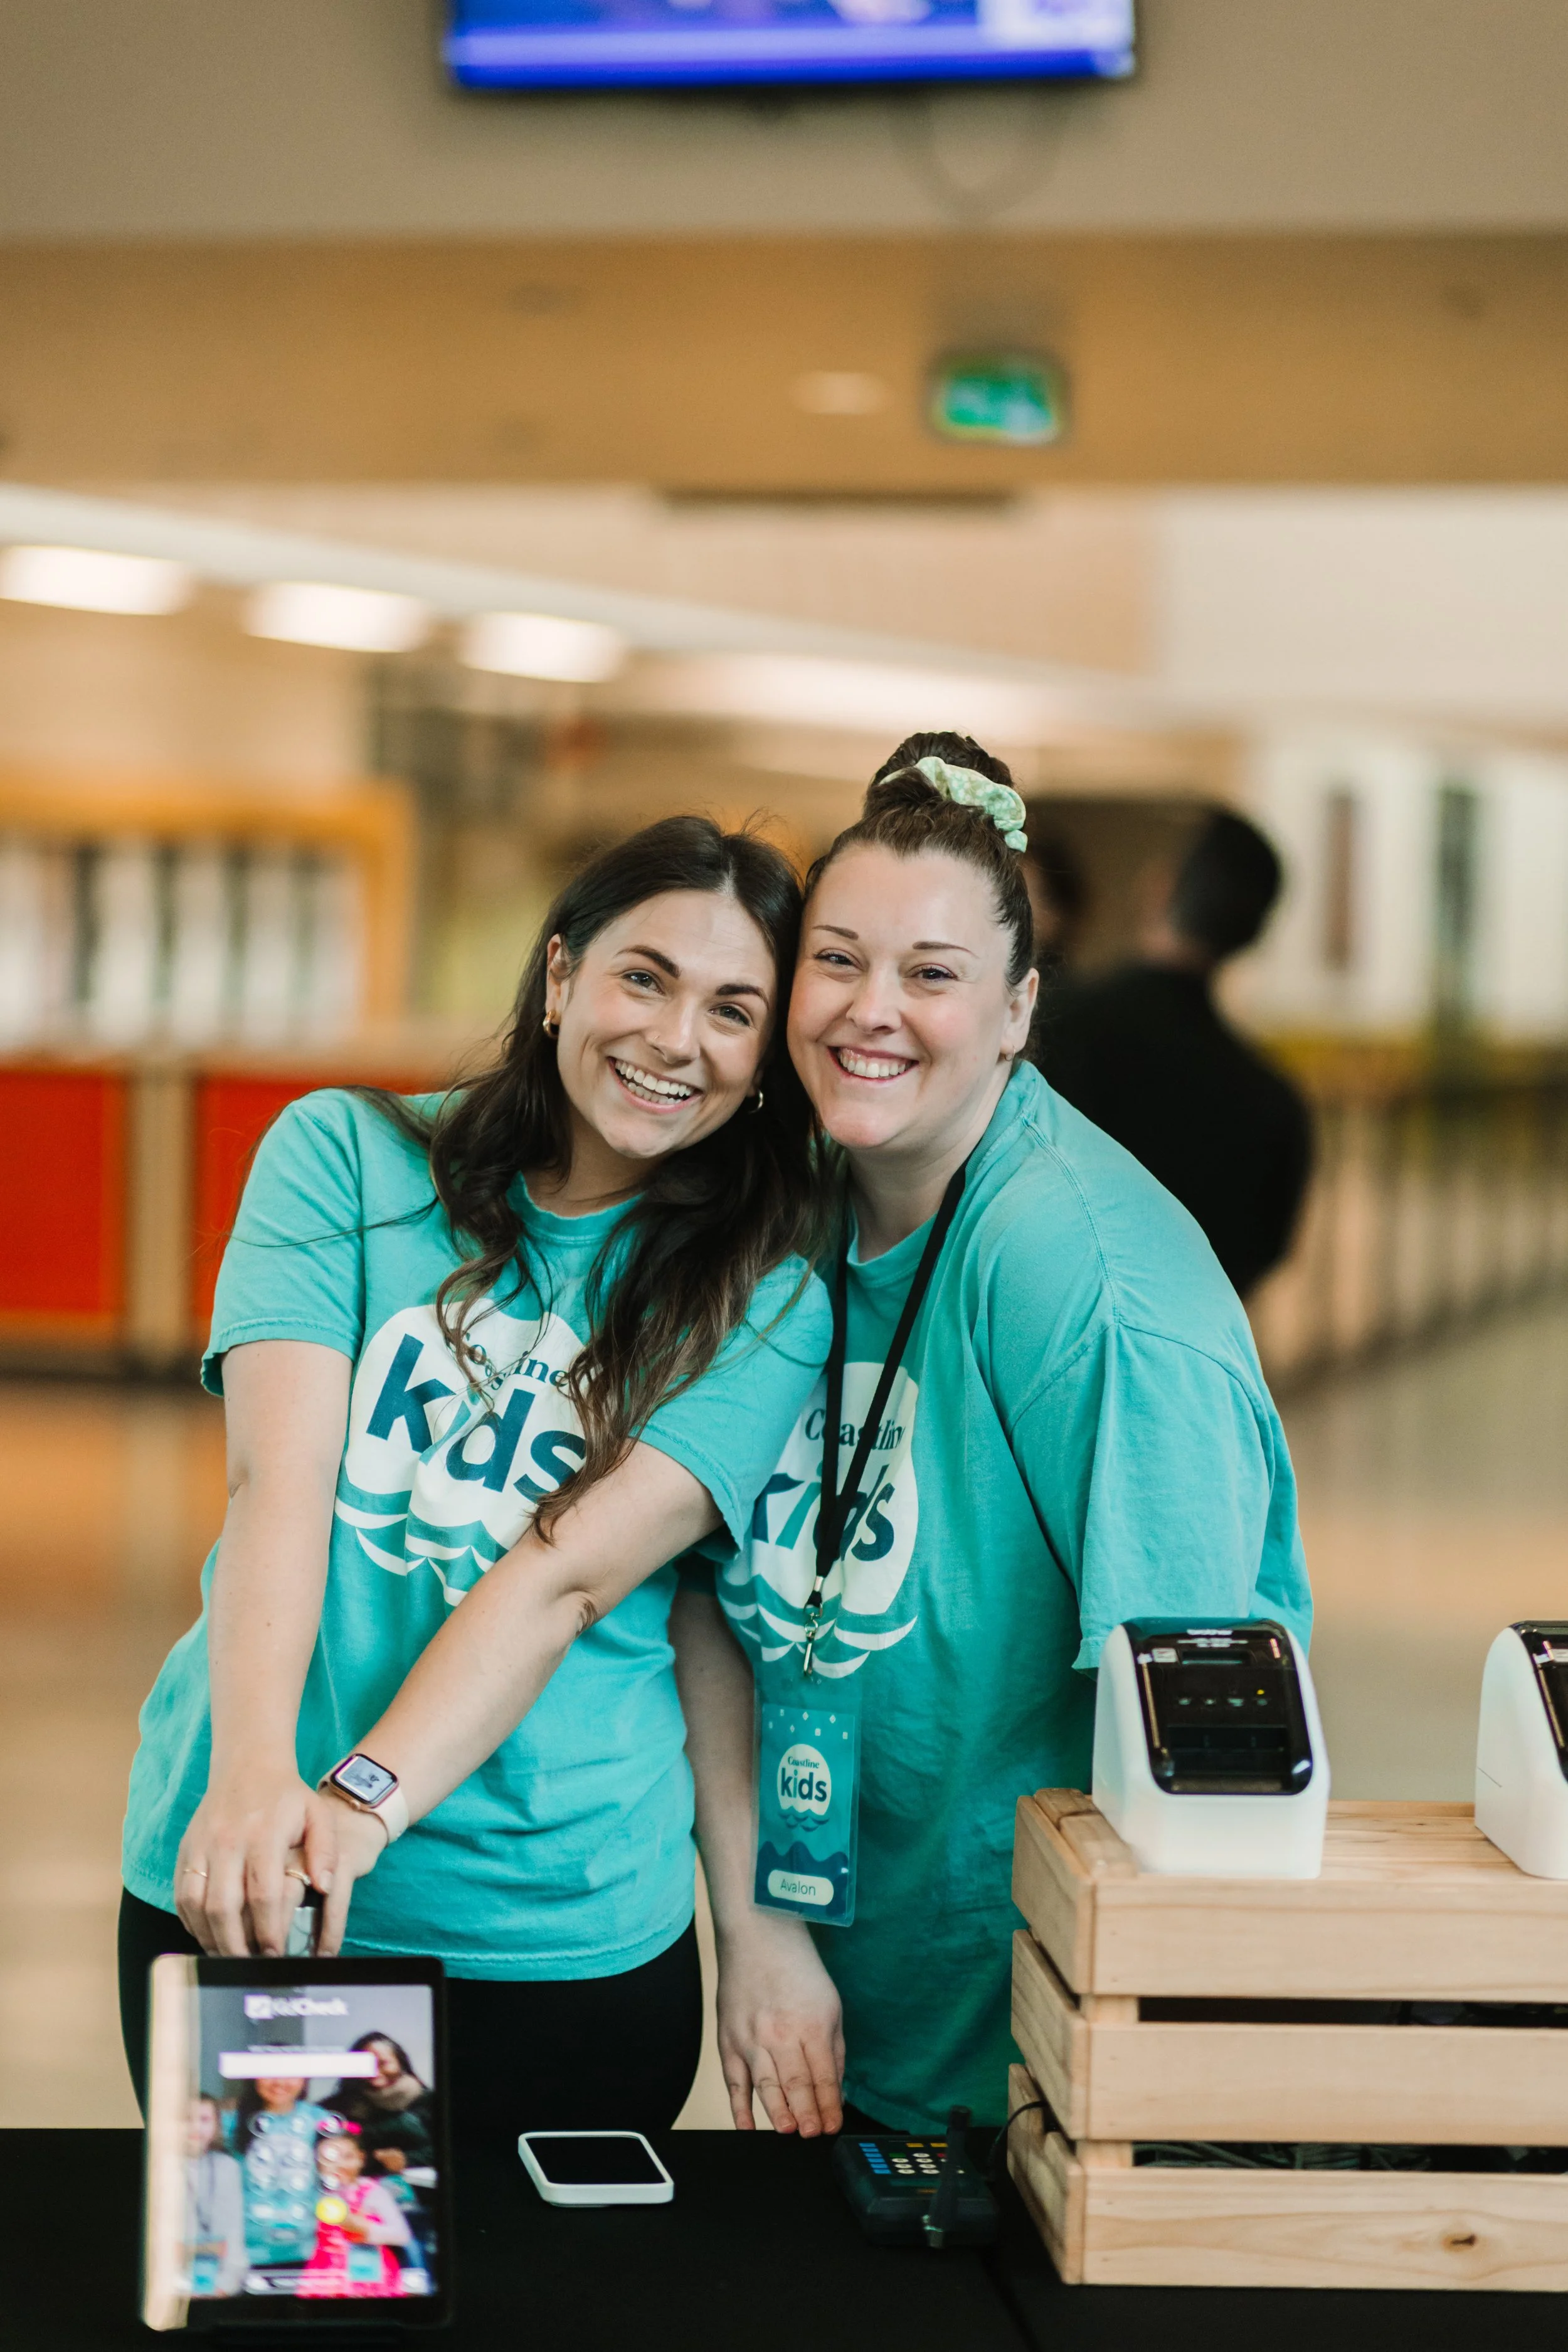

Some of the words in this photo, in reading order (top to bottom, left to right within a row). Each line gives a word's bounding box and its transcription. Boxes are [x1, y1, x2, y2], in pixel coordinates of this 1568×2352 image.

[805, 1408, 906, 1450] Catlin
[788, 1756, 819, 1769] Coastline
[781, 1767, 827, 1802] kids
[780, 1878, 816, 1895] Avalon
